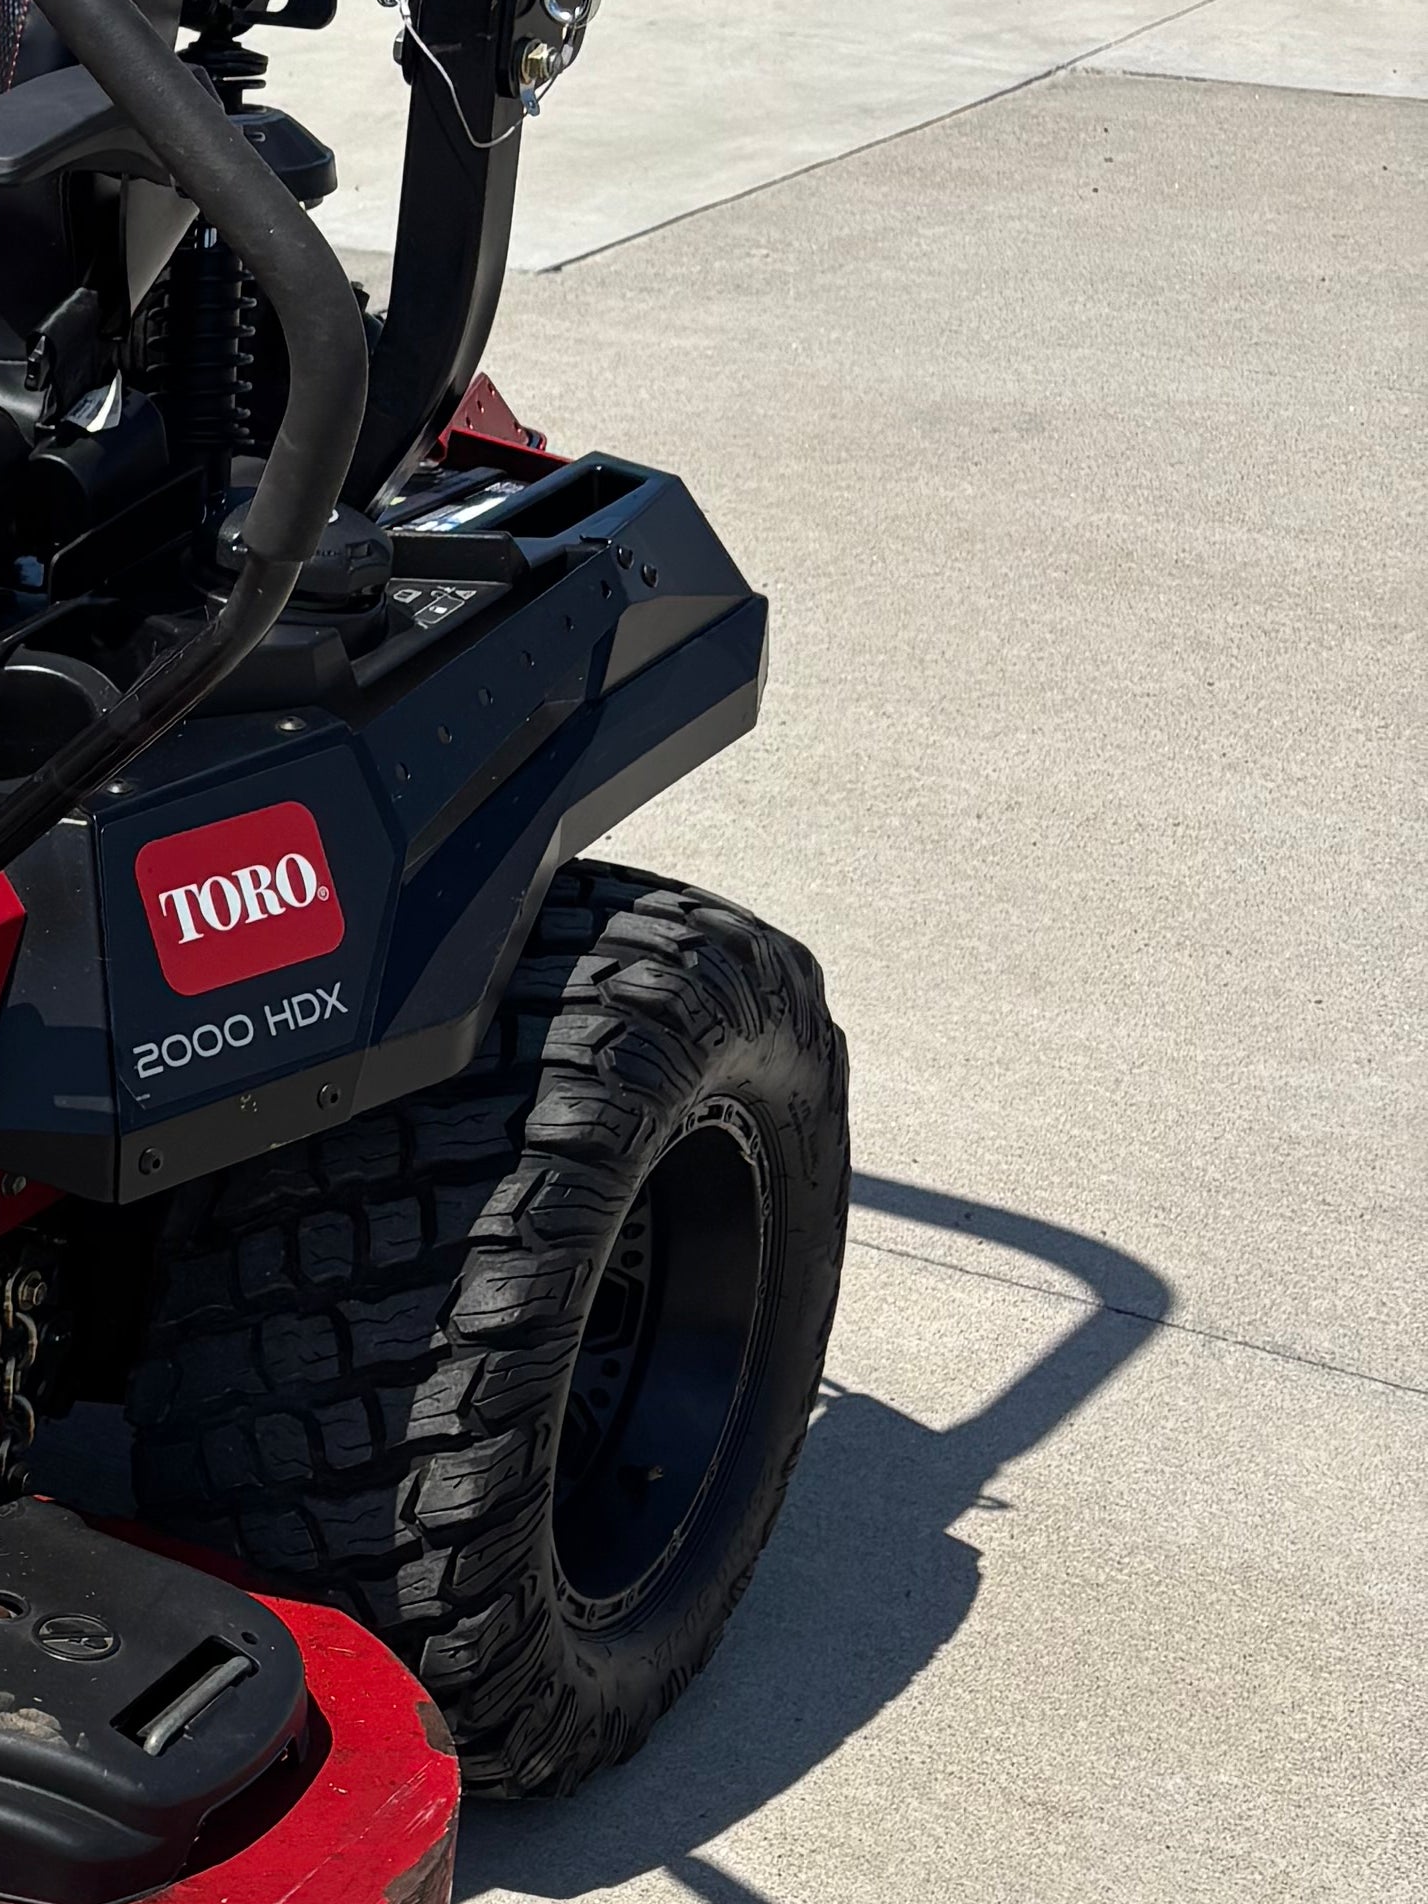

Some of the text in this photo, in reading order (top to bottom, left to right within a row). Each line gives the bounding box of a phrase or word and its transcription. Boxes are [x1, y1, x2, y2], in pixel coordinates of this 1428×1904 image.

[158, 853, 319, 945] TORO
[132, 981, 349, 1079] 2000 HDX
